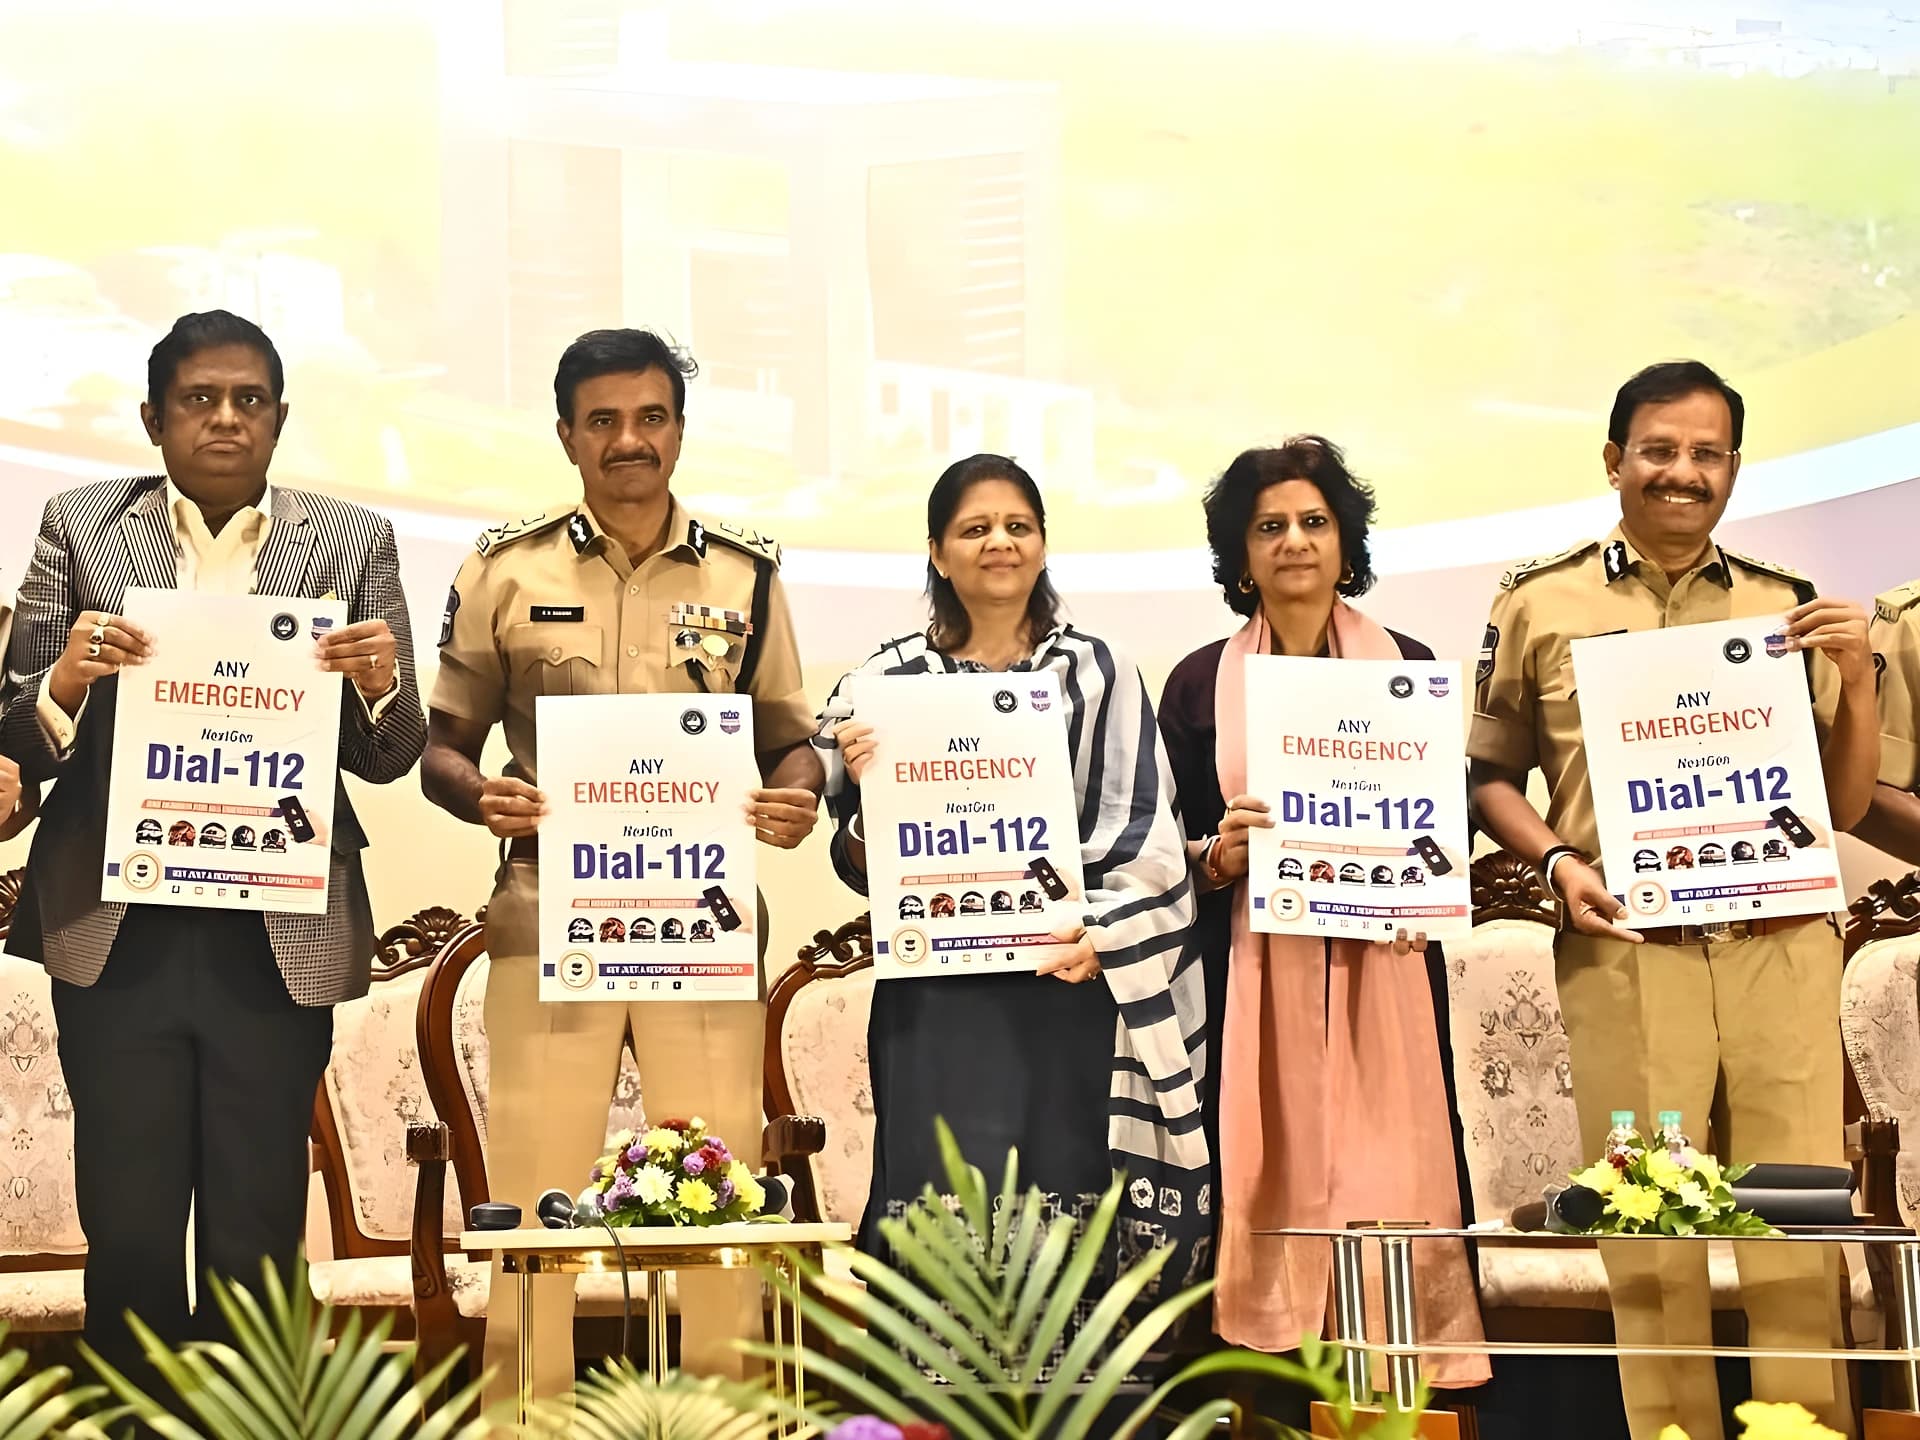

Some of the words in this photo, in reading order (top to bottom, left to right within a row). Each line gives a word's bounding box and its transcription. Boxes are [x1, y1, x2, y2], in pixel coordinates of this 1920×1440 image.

[213, 660, 250, 679] ANY
[153, 679, 305, 712] EMERGENCY
[1675, 690, 1712, 709] ANY
[1336, 718, 1372, 734] ANY
[1620, 706, 1773, 743] EMERGENCY
[947, 737, 981, 753] ANY
[1282, 734, 1429, 762] EMERGENCY
[146, 742, 305, 790] Dial-112
[629, 758, 665, 775] ANY
[894, 757, 1037, 783] EMERGENCY
[573, 781, 721, 804] EMERGENCY
[1627, 765, 1792, 814] Dial-112
[1282, 790, 1436, 830] Dial-112
[898, 816, 1050, 858] Dial-112
[573, 843, 726, 880] Dial-112
